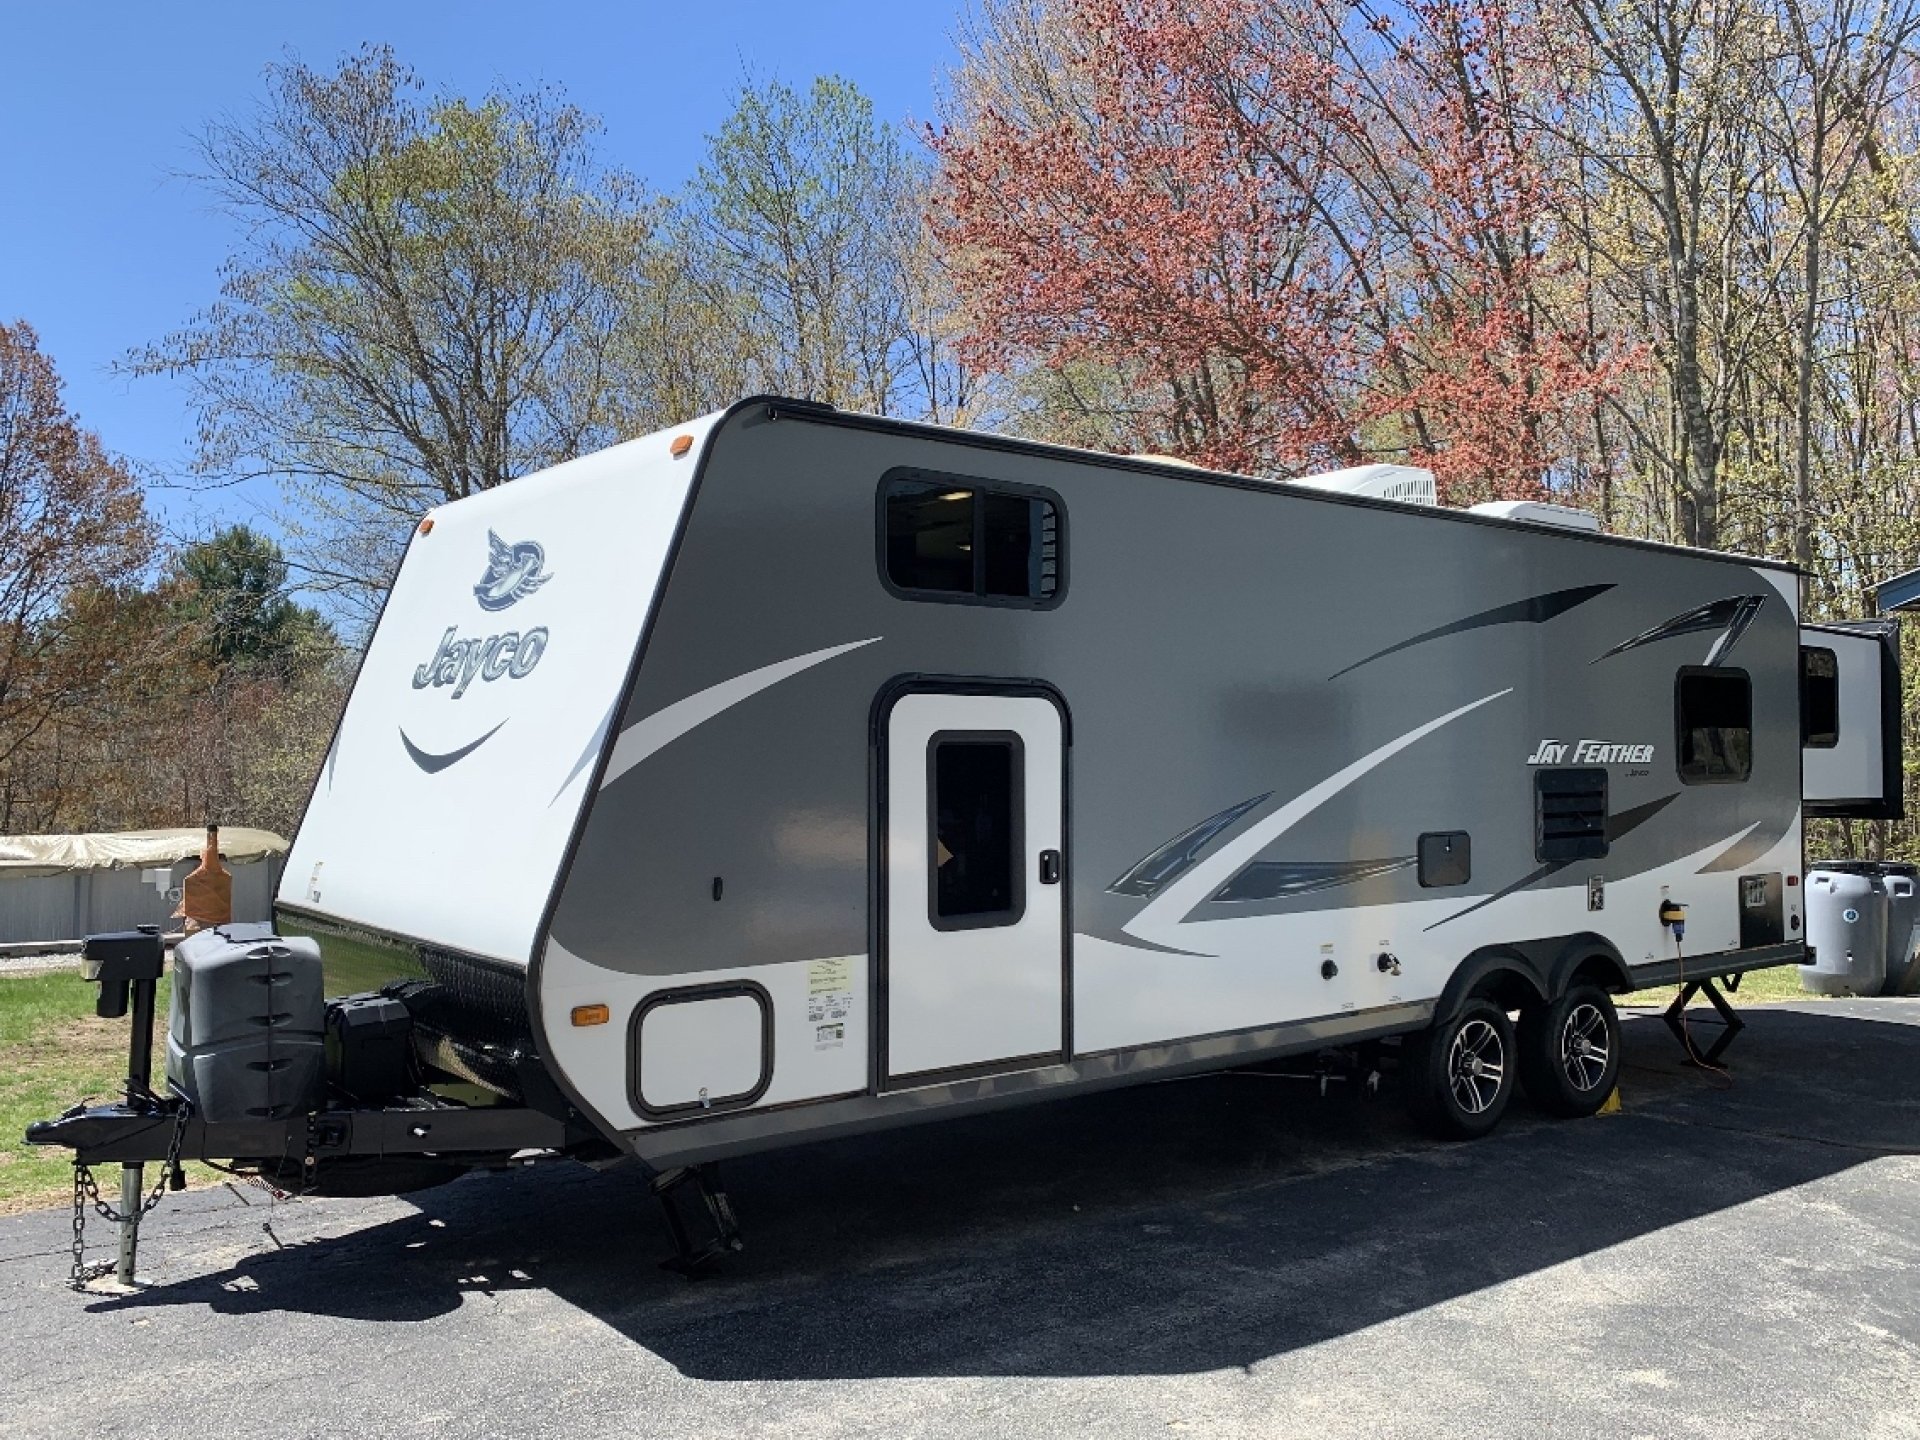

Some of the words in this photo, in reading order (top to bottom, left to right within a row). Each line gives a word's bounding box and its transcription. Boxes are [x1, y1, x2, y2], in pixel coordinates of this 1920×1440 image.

[412, 624, 549, 700] Jayco
[1526, 739, 1569, 765] JAY
[1571, 739, 1655, 764] FEATHER
